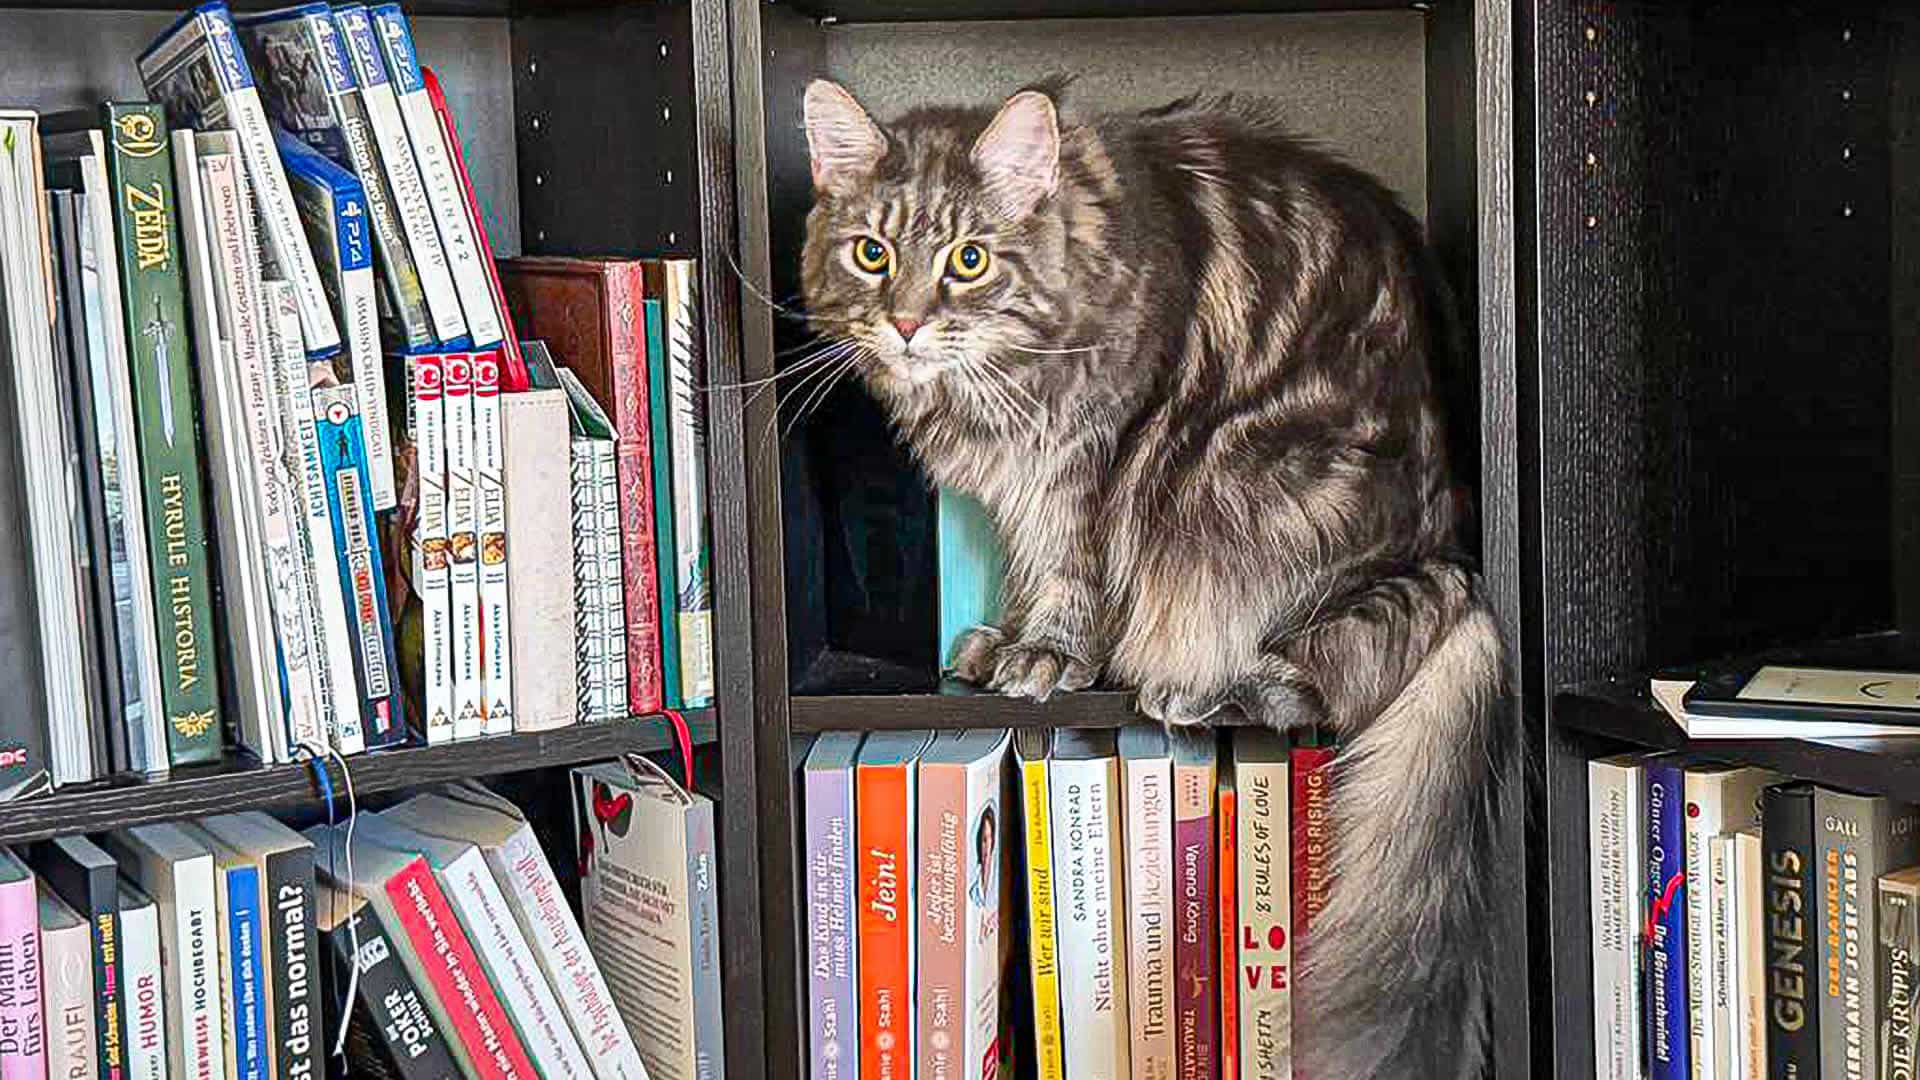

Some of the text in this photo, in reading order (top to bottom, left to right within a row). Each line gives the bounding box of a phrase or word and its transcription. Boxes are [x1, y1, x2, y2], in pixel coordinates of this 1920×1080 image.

[346, 115, 376, 170] Horizon
[361, 168, 384, 203] Zero
[124, 179, 172, 270] ZELDA
[346, 221, 364, 263] PS4
[457, 249, 469, 261] 2
[283, 339, 309, 411] ERLEBEN
[296, 417, 327, 519] ACHTSAMKEIT
[160, 473, 198, 689] HYRULE HISTORIA
[1136, 773, 1163, 906] Beziehungen
[1252, 775, 1271, 912] 8 RULES OF LOVE
[1304, 773, 1324, 838] RISING
[1648, 782, 1668, 895] Günter Ogger
[1824, 816, 1857, 836] GALL
[867, 847, 899, 922] Jein!
[924, 852, 944, 922] Jeder ist
[1067, 783, 1086, 920] SANDRA KONRAD
[1182, 844, 1200, 943] Verena König
[1306, 841, 1321, 861] IS
[1841, 851, 1858, 900] ABS
[809, 853, 832, 979] Das Kind in dir
[827, 816, 846, 977] muss Heimat finden
[1029, 866, 1054, 976] Wer wir sind
[1085, 782, 1112, 1011] Nicht ohne meine Eltern
[1140, 912, 1163, 952] und
[1822, 847, 1841, 996] DER BANKIER
[1842, 904, 1861, 971] JOSEF
[187, 908, 209, 1010] HOCHBEGABT
[277, 885, 310, 997] normal?
[1769, 849, 1807, 1033] GENESIS
[0, 943, 18, 1054] Der Mann
[16, 932, 41, 1056] fürs Lieben
[137, 974, 157, 1048] HUMOR
[283, 1004, 311, 1054] das
[381, 987, 428, 1058] POKER
[400, 989, 436, 1038] SCHULE
[821, 997, 837, 1039] Stahl
[875, 988, 891, 1027] Stahl
[931, 988, 948, 1026] Stahl
[1141, 958, 1165, 1040] Trauma
[1652, 924, 1670, 1061] Der Börsenschwindel
[1889, 946, 1914, 1039] KRUPPS
[1254, 1009, 1273, 1070] SHETTY
